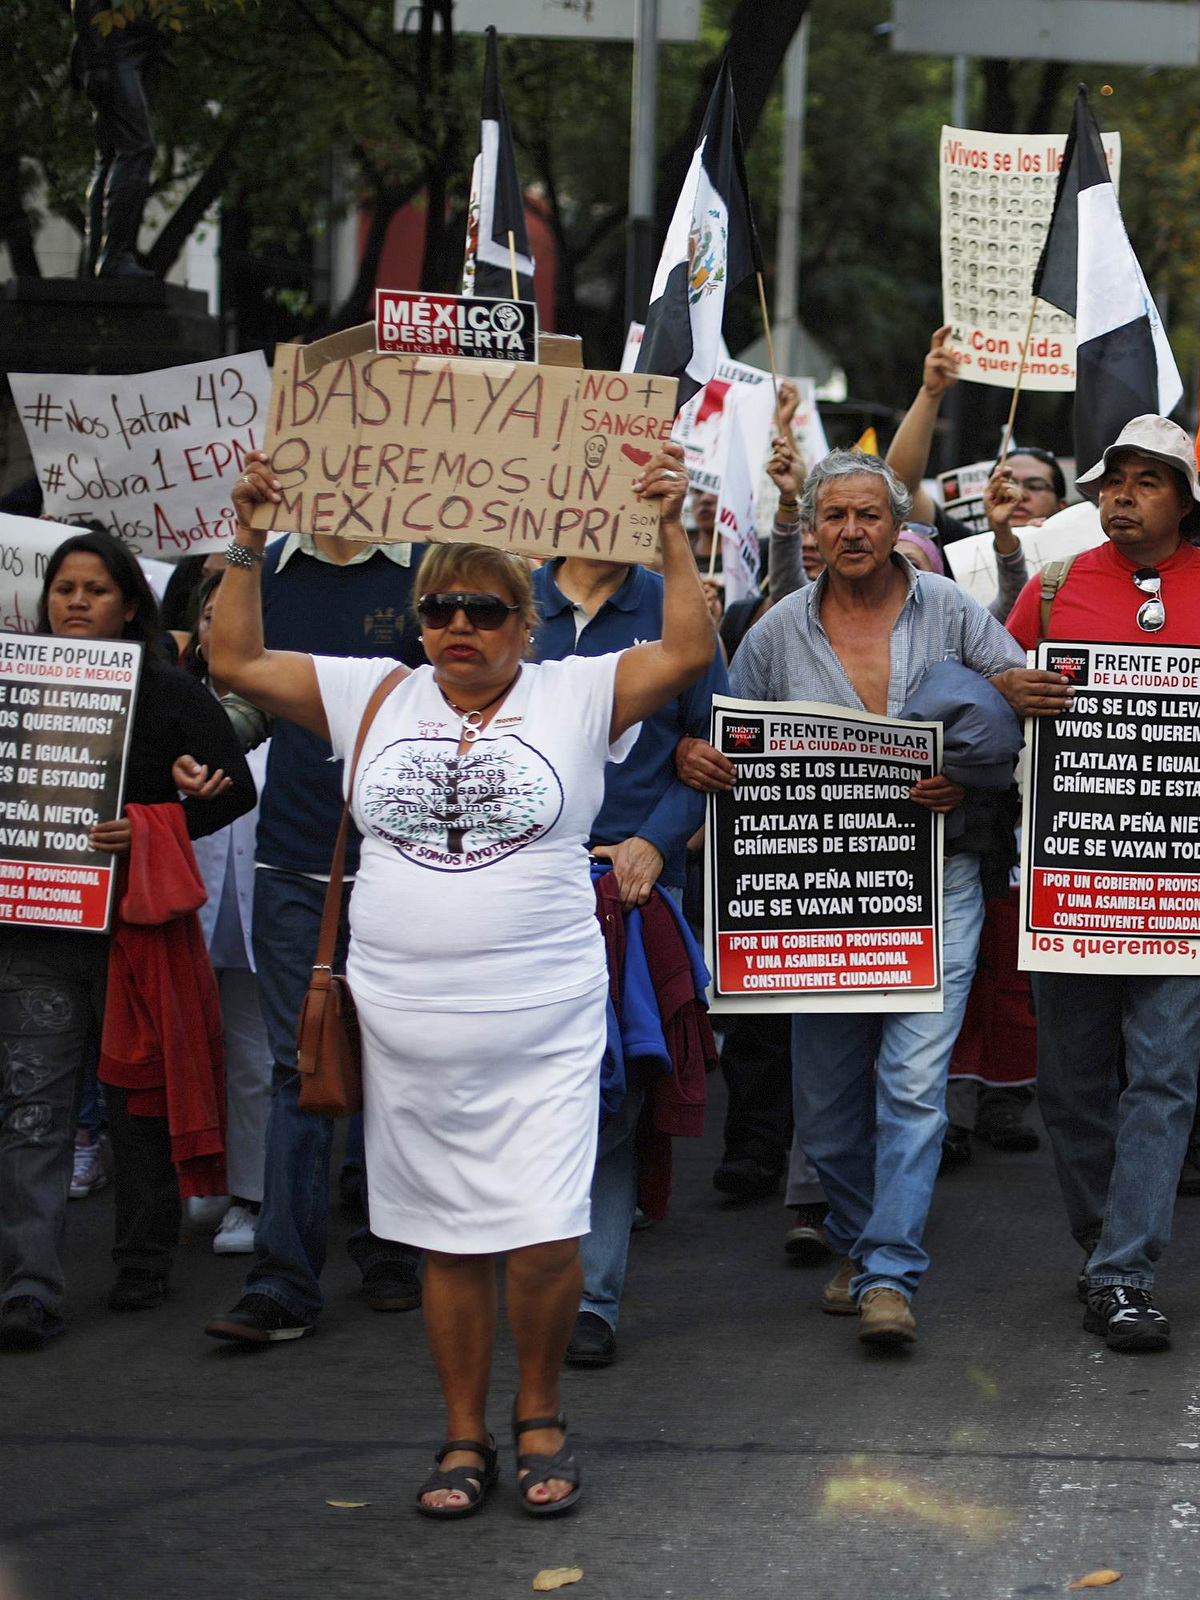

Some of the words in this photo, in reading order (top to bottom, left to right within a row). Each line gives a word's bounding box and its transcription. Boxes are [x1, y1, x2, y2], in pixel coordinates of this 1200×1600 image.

[994, 152, 1011, 171] se
[1018, 148, 1040, 172] los
[383, 297, 524, 334] MÉXICO
[383, 324, 525, 350] DESPIERTA
[385, 343, 465, 356] CHINGADA
[473, 349, 526, 361] MADRE
[196, 368, 258, 428] 43
[581, 409, 674, 440] SANGRE
[630, 513, 659, 526] SON
[631, 531, 653, 547] 43
[52, 647, 133, 669] POPULAR
[1094, 653, 1162, 672] FRENTE
[1094, 672, 1109, 685] DE
[1113, 673, 1127, 686] LA
[1131, 674, 1179, 688] CIUDAD
[1183, 676, 1197, 688] DE
[1102, 698, 1122, 715] SE
[1127, 699, 1157, 717] LOS
[769, 722, 838, 740] FRENTE
[843, 727, 927, 750] POPULAR
[1055, 720, 1102, 738] VIVOS
[1107, 722, 1137, 740] LOS
[769, 740, 786, 751] DE
[790, 740, 804, 751] LA
[808, 740, 856, 752] CIUDAD
[860, 743, 876, 754] DE
[880, 746, 929, 760] MEXICO
[780, 763, 800, 779] SE
[806, 763, 835, 778] LOS
[1055, 752, 1138, 771] ¡TLATLAYA
[1143, 755, 1152, 771] E
[398, 767, 506, 780] enterrarnos
[386, 785, 425, 798] pero
[431, 786, 453, 796] no
[733, 785, 781, 801] VIVOS
[786, 785, 816, 800] LOS
[1053, 772, 1136, 795] CRÍMENES
[1140, 780, 1160, 796] DE
[397, 804, 429, 815] que
[420, 818, 487, 831] semilla
[734, 815, 819, 835] ¡TLATLAYA
[823, 814, 833, 829] E
[839, 813, 916, 829] IGUALA...
[1053, 811, 1115, 832] ¡FUERA
[1120, 812, 1166, 833] PEÑA
[416, 846, 462, 866] SOMOS
[465, 822, 544, 866] AYOTZINAPA
[734, 834, 818, 855] CRÍMENES
[823, 837, 843, 852] DE
[849, 835, 916, 851] ESTADO!
[1044, 837, 1080, 856] QUE
[1084, 839, 1106, 856] SE
[1111, 840, 1166, 858] VAYAN
[736, 873, 799, 895] ¡FUERA
[804, 869, 851, 889] PEÑA
[856, 870, 914, 890] NIETO;
[1043, 873, 1070, 888] ¡POR
[1074, 874, 1090, 889] UN
[1094, 876, 1154, 891] GOBIERNO
[728, 899, 765, 918] QUE
[769, 899, 792, 916] SE
[797, 897, 853, 915] VAYAN
[858, 895, 922, 913] TODOS!
[1057, 893, 1065, 907] Y
[1067, 894, 1092, 909] UNA
[1095, 896, 1156, 910] ASAMBLEA
[1053, 912, 1145, 929] CONSTITUYENTE
[730, 936, 758, 950] ¡POR
[762, 936, 779, 950] UN
[782, 933, 842, 949] GOBIERNO
[846, 932, 923, 947] PROVISIONAL
[1073, 939, 1197, 959] queremos,
[745, 955, 753, 969] Y
[756, 955, 782, 969] UNA
[784, 953, 847, 968] ASAMBLEA
[850, 951, 908, 966] NACIONAL
[742, 972, 836, 988] CONSTITUYENTE
[839, 970, 912, 986] CIUDADANA!
